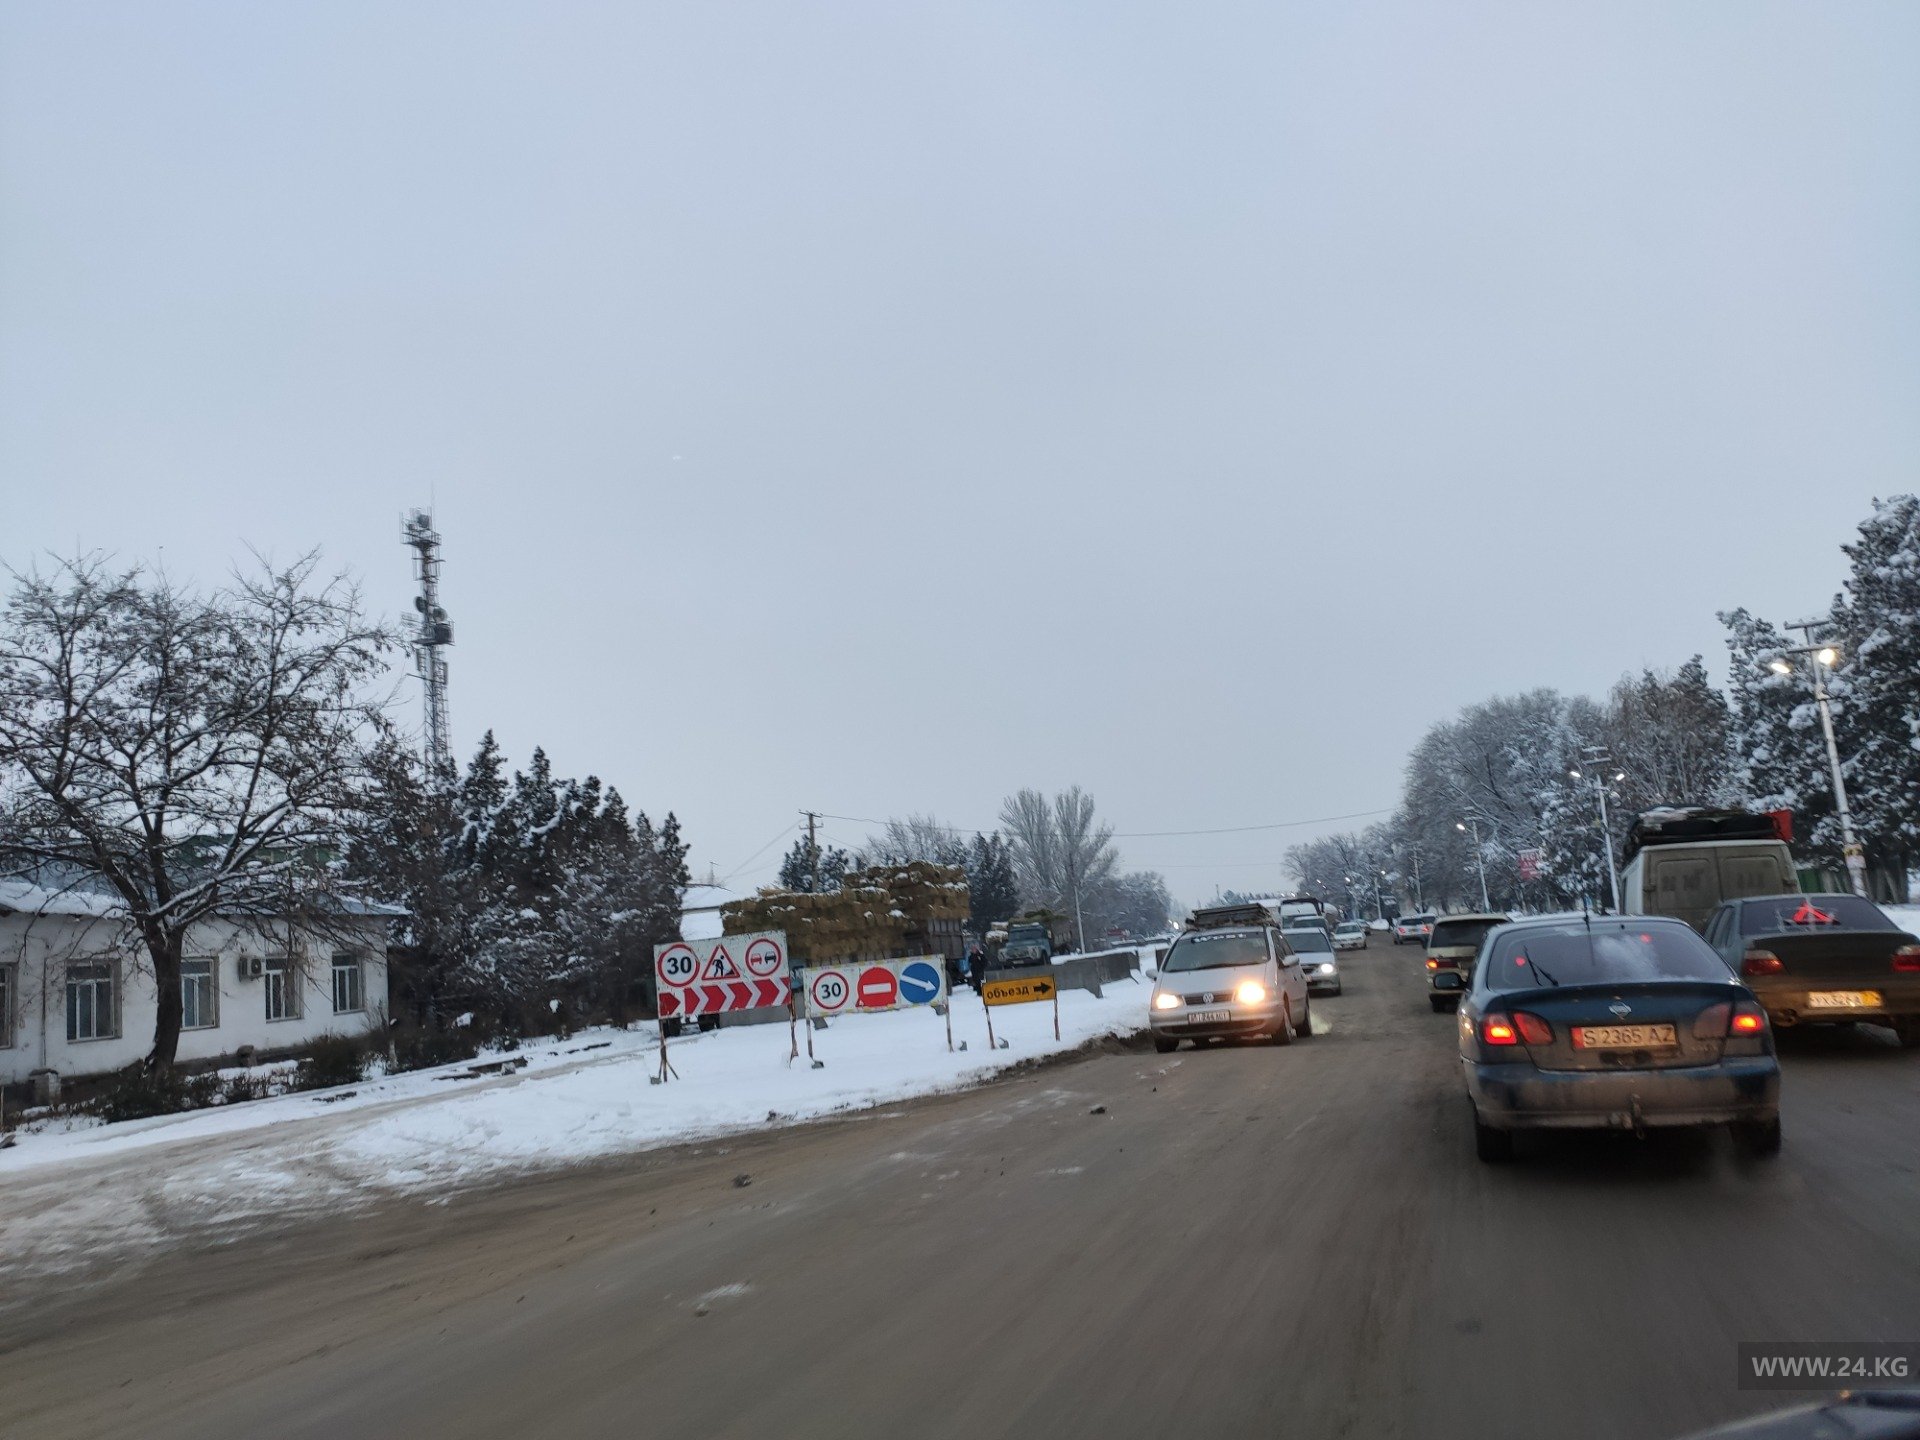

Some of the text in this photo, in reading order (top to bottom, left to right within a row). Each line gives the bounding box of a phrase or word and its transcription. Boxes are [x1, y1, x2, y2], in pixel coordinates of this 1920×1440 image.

[667, 956, 692, 975] 30
[821, 982, 841, 999] 30
[1584, 1026, 1673, 1045] S 2365 AZ
